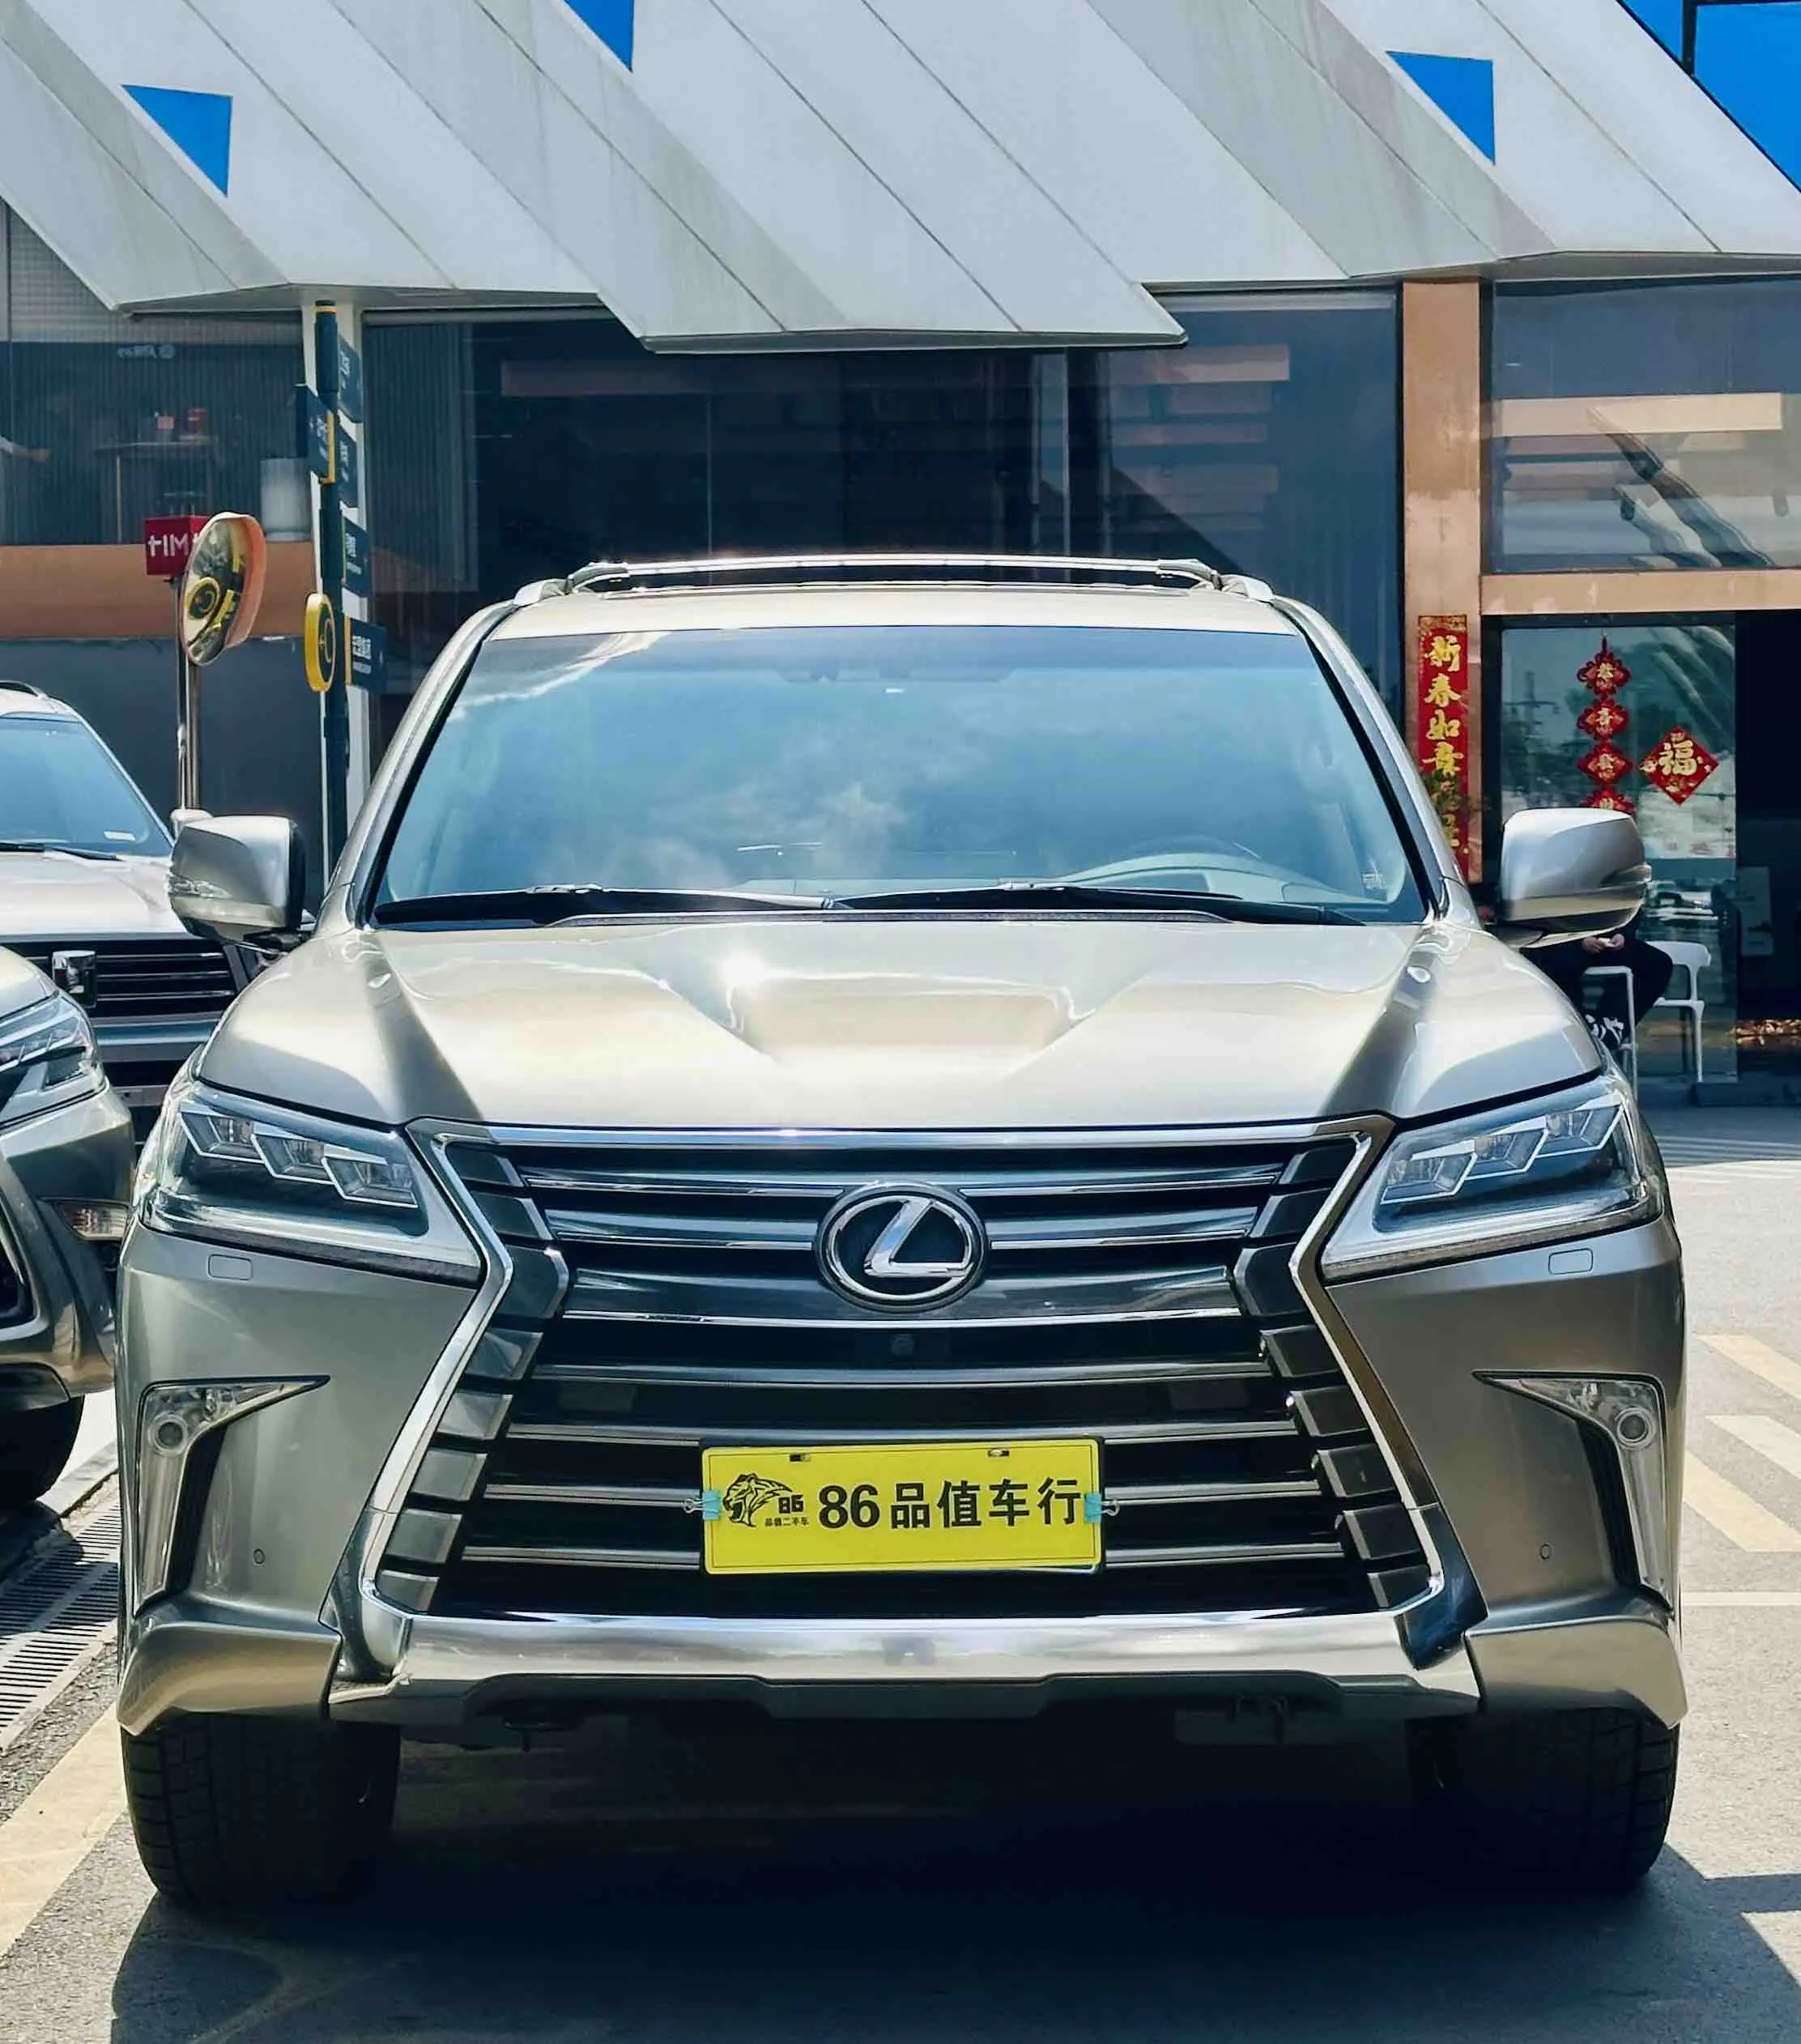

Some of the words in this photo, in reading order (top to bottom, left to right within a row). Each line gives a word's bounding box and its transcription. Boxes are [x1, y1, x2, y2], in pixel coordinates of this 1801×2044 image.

[1658, 739, 1697, 776] 福
[778, 1494, 804, 1514] 86
[818, 1476, 1082, 1530] 86品值车行
